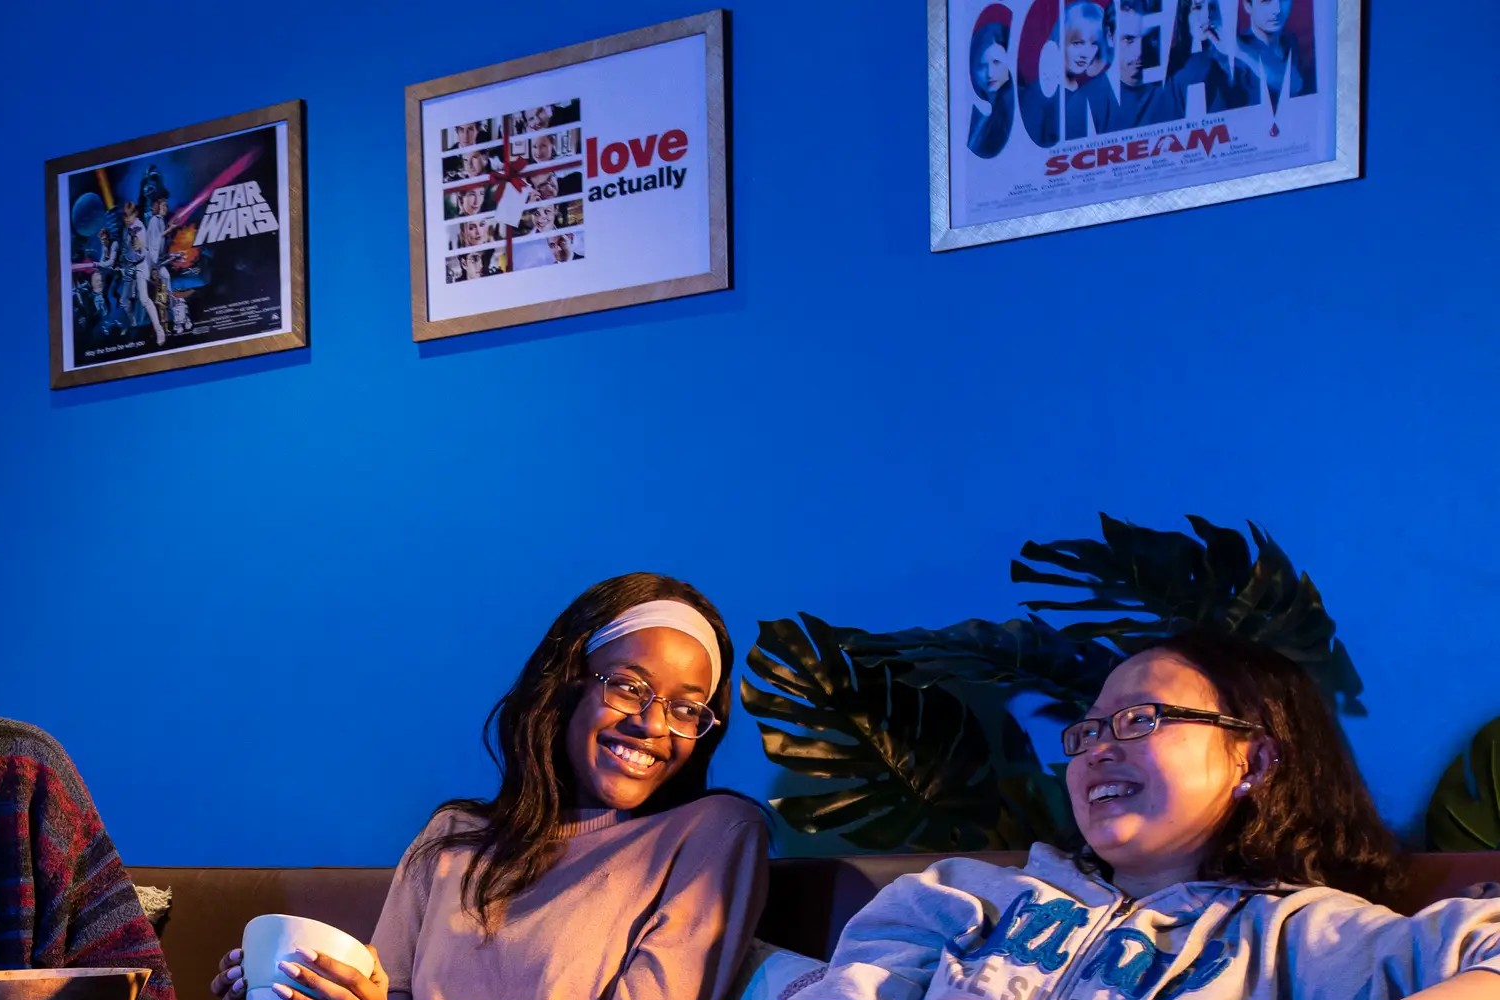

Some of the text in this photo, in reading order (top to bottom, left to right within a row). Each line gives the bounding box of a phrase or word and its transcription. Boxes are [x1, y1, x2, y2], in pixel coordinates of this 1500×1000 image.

[586, 129, 688, 178] love
[1044, 124, 1231, 176] SCREAM
[205, 180, 267, 215] STAR
[588, 166, 687, 202] actually
[192, 202, 279, 246] WARS
